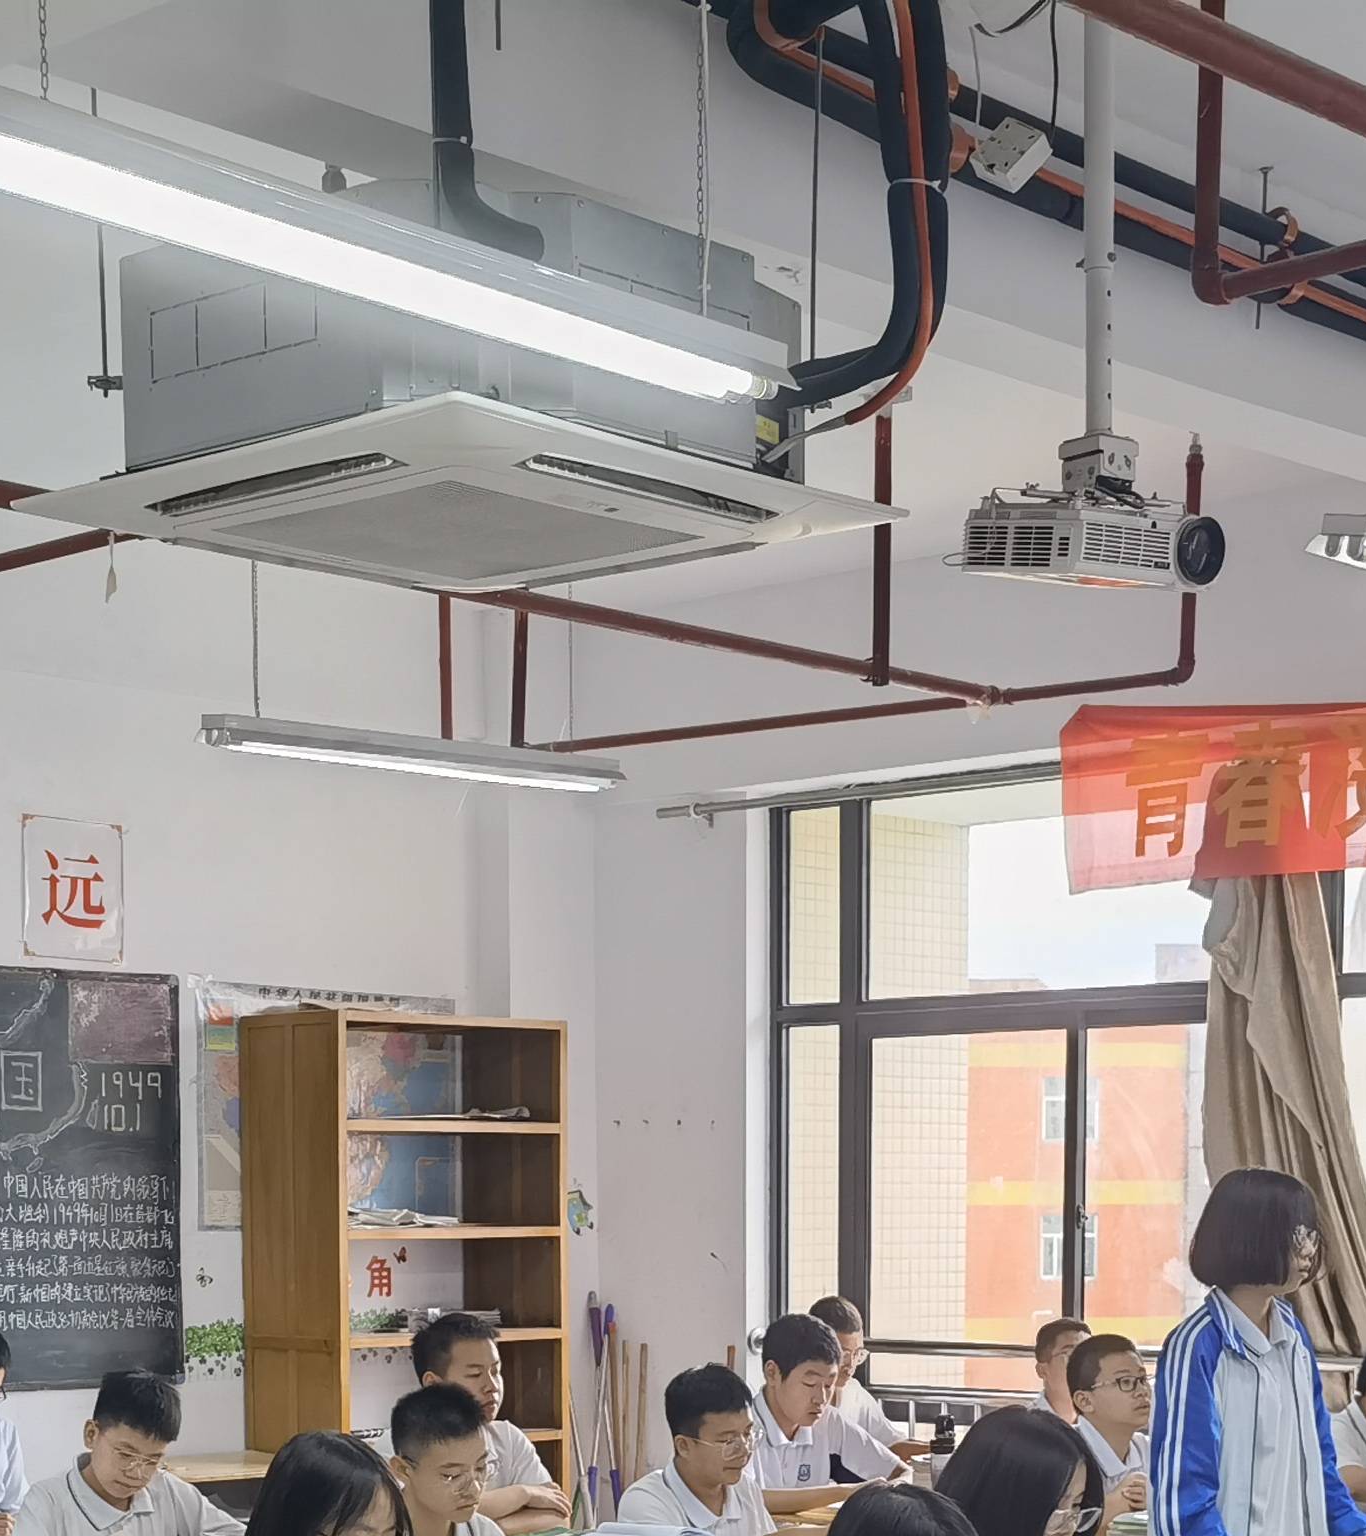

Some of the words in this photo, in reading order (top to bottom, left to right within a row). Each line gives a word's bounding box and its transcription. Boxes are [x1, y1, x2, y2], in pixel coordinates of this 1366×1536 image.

[41, 849, 106, 931] 远
[100, 1071, 163, 1099] 1949
[102, 1104, 142, 1132] 10.1
[366, 1255, 392, 1298] 角
